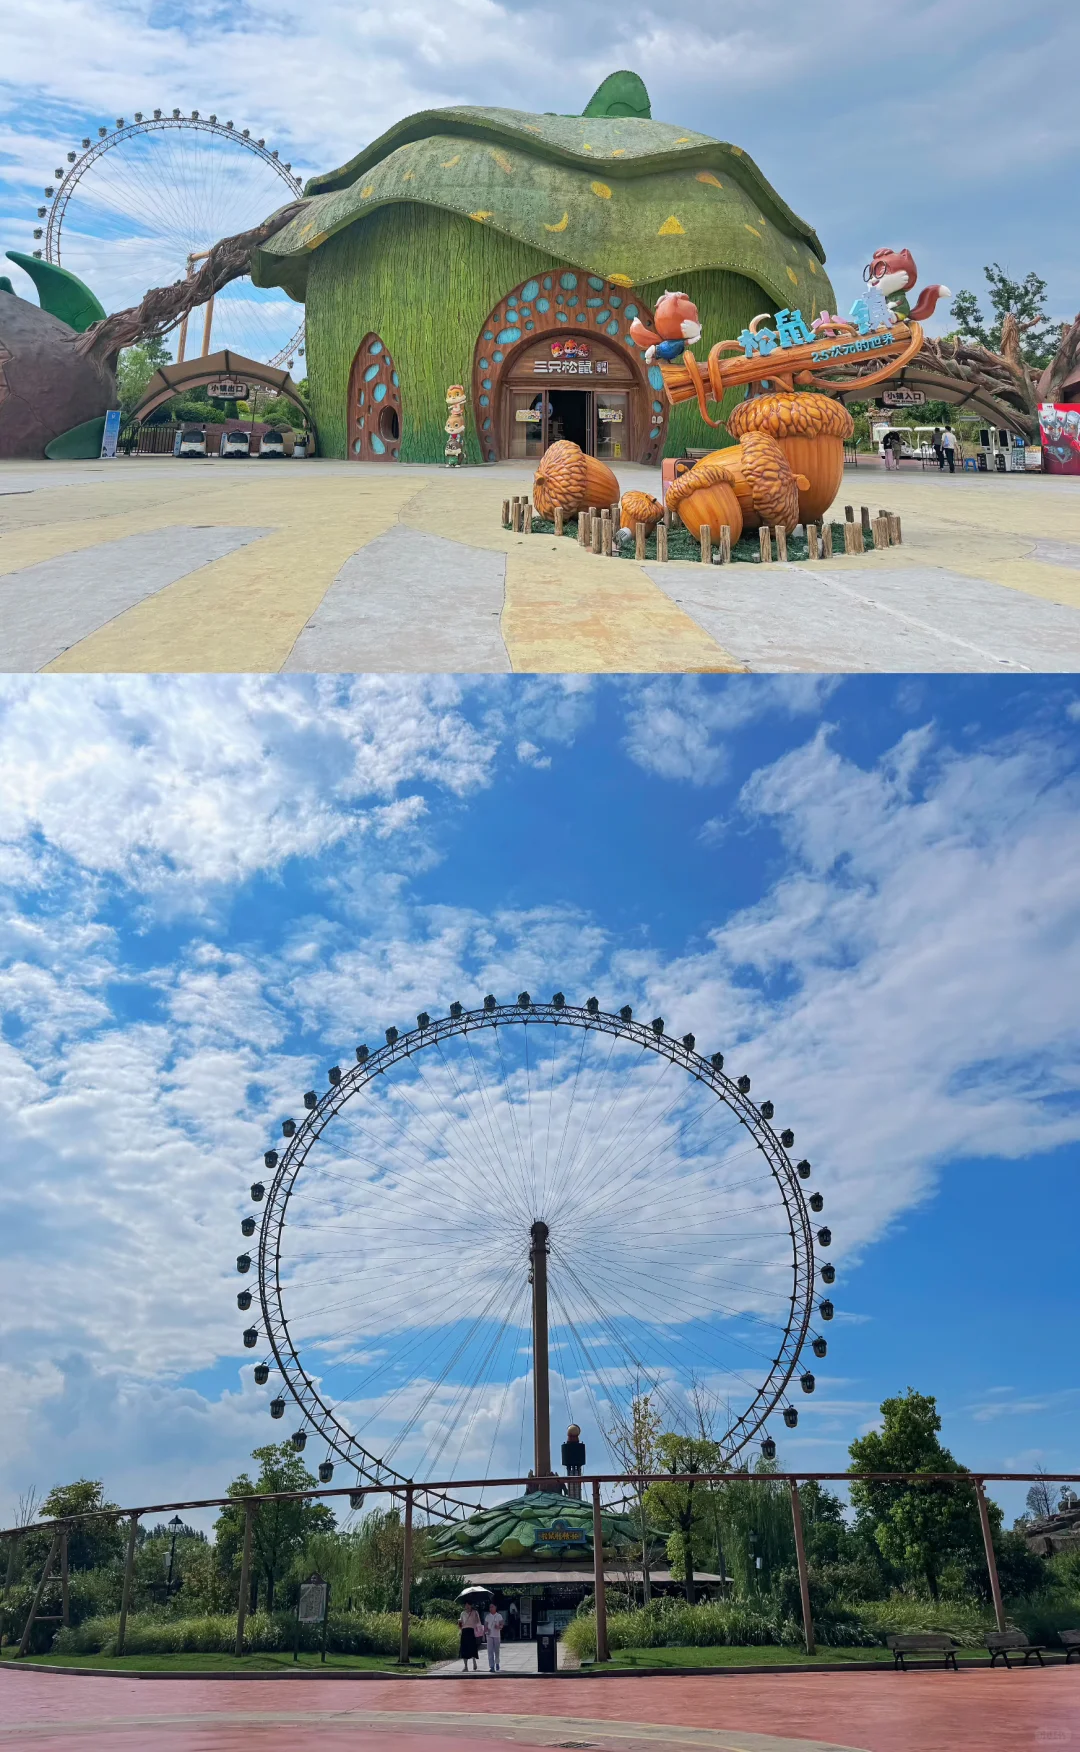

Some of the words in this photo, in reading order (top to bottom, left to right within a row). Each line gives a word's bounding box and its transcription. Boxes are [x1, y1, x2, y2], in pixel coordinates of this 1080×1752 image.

[737, 287, 894, 359] 松鼠小镇
[533, 360, 593, 374] 三只松鼠
[211, 384, 244, 393] 小镇出口
[887, 392, 921, 400] 小镇入口
